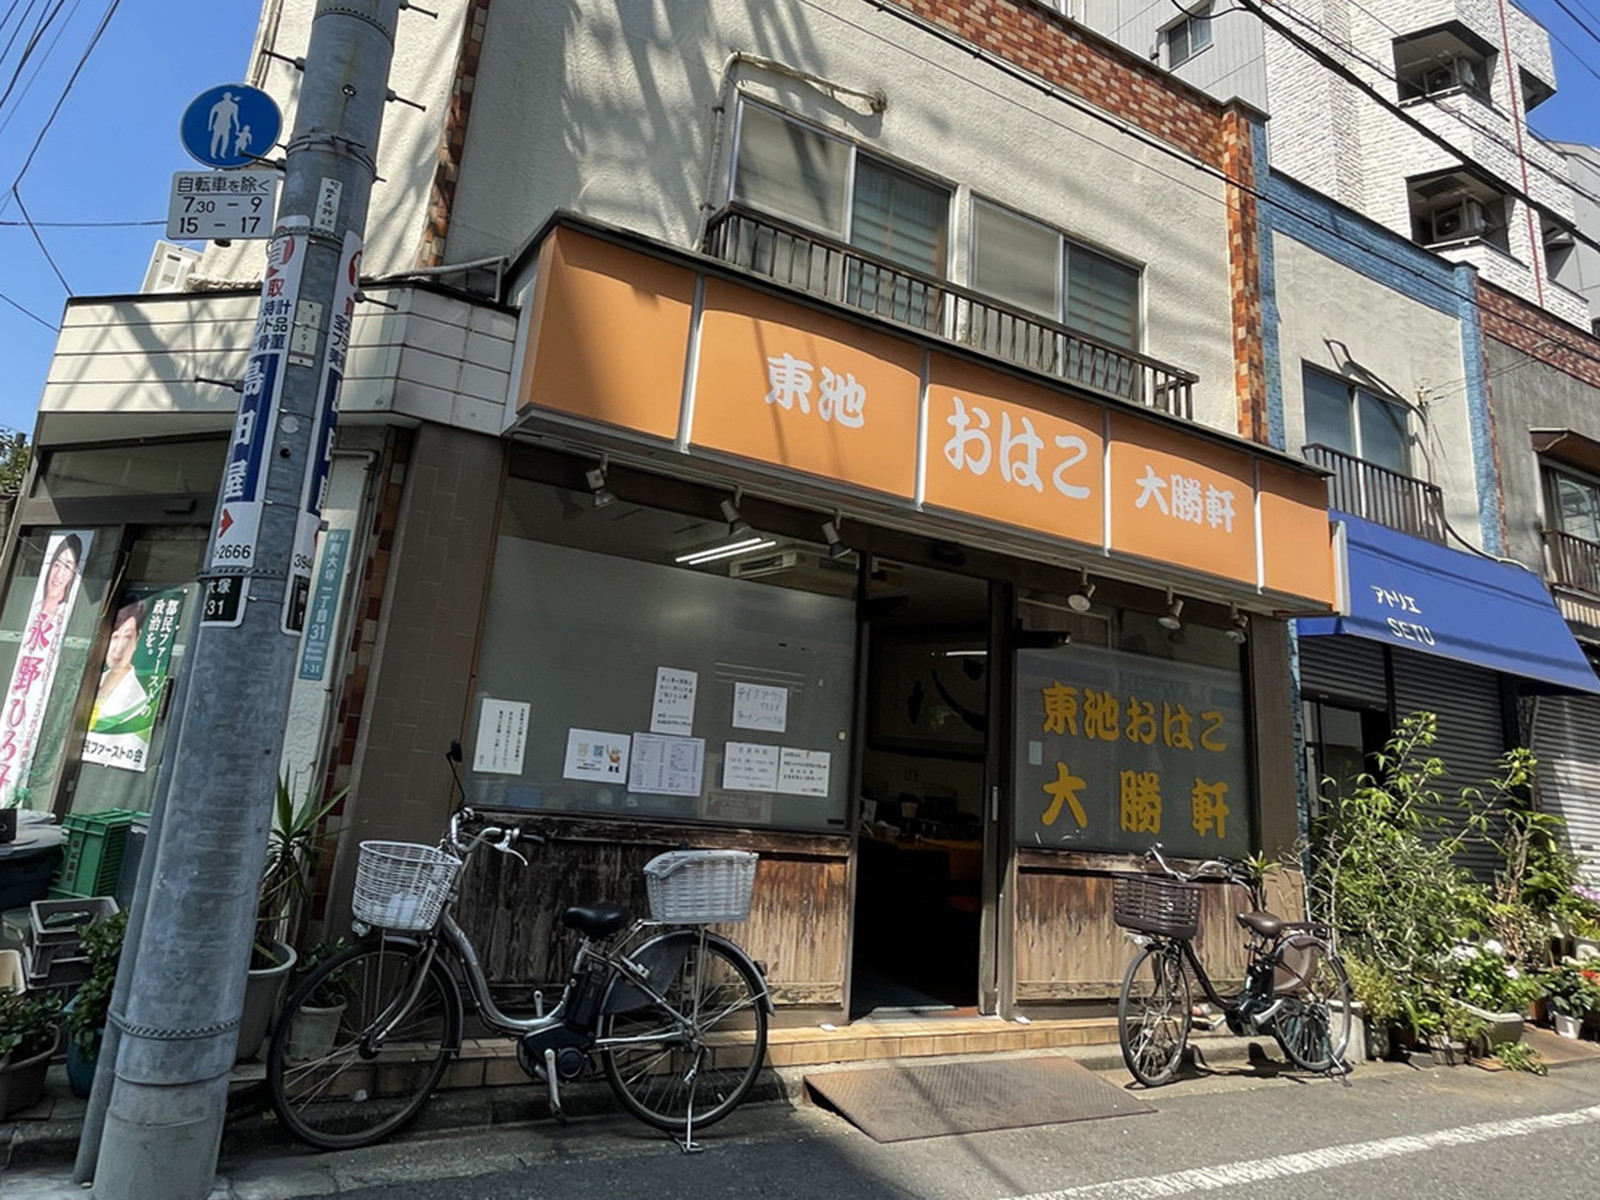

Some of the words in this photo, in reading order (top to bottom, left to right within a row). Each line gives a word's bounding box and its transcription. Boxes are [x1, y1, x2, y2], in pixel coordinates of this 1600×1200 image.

[178, 176, 270, 193] 自転車を除く
[251, 196, 262, 213] 9
[180, 217, 199, 233] 15
[241, 217, 261, 233] 17
[765, 353, 867, 429] 東池
[943, 396, 1091, 499] おはこ
[1135, 465, 1235, 533] 大勝軒
[309, 624, 326, 640] 31
[1386, 616, 1436, 646] SETU
[1041, 681, 1228, 751] 東池おはこ
[1041, 761, 1230, 839] 大勝軒
